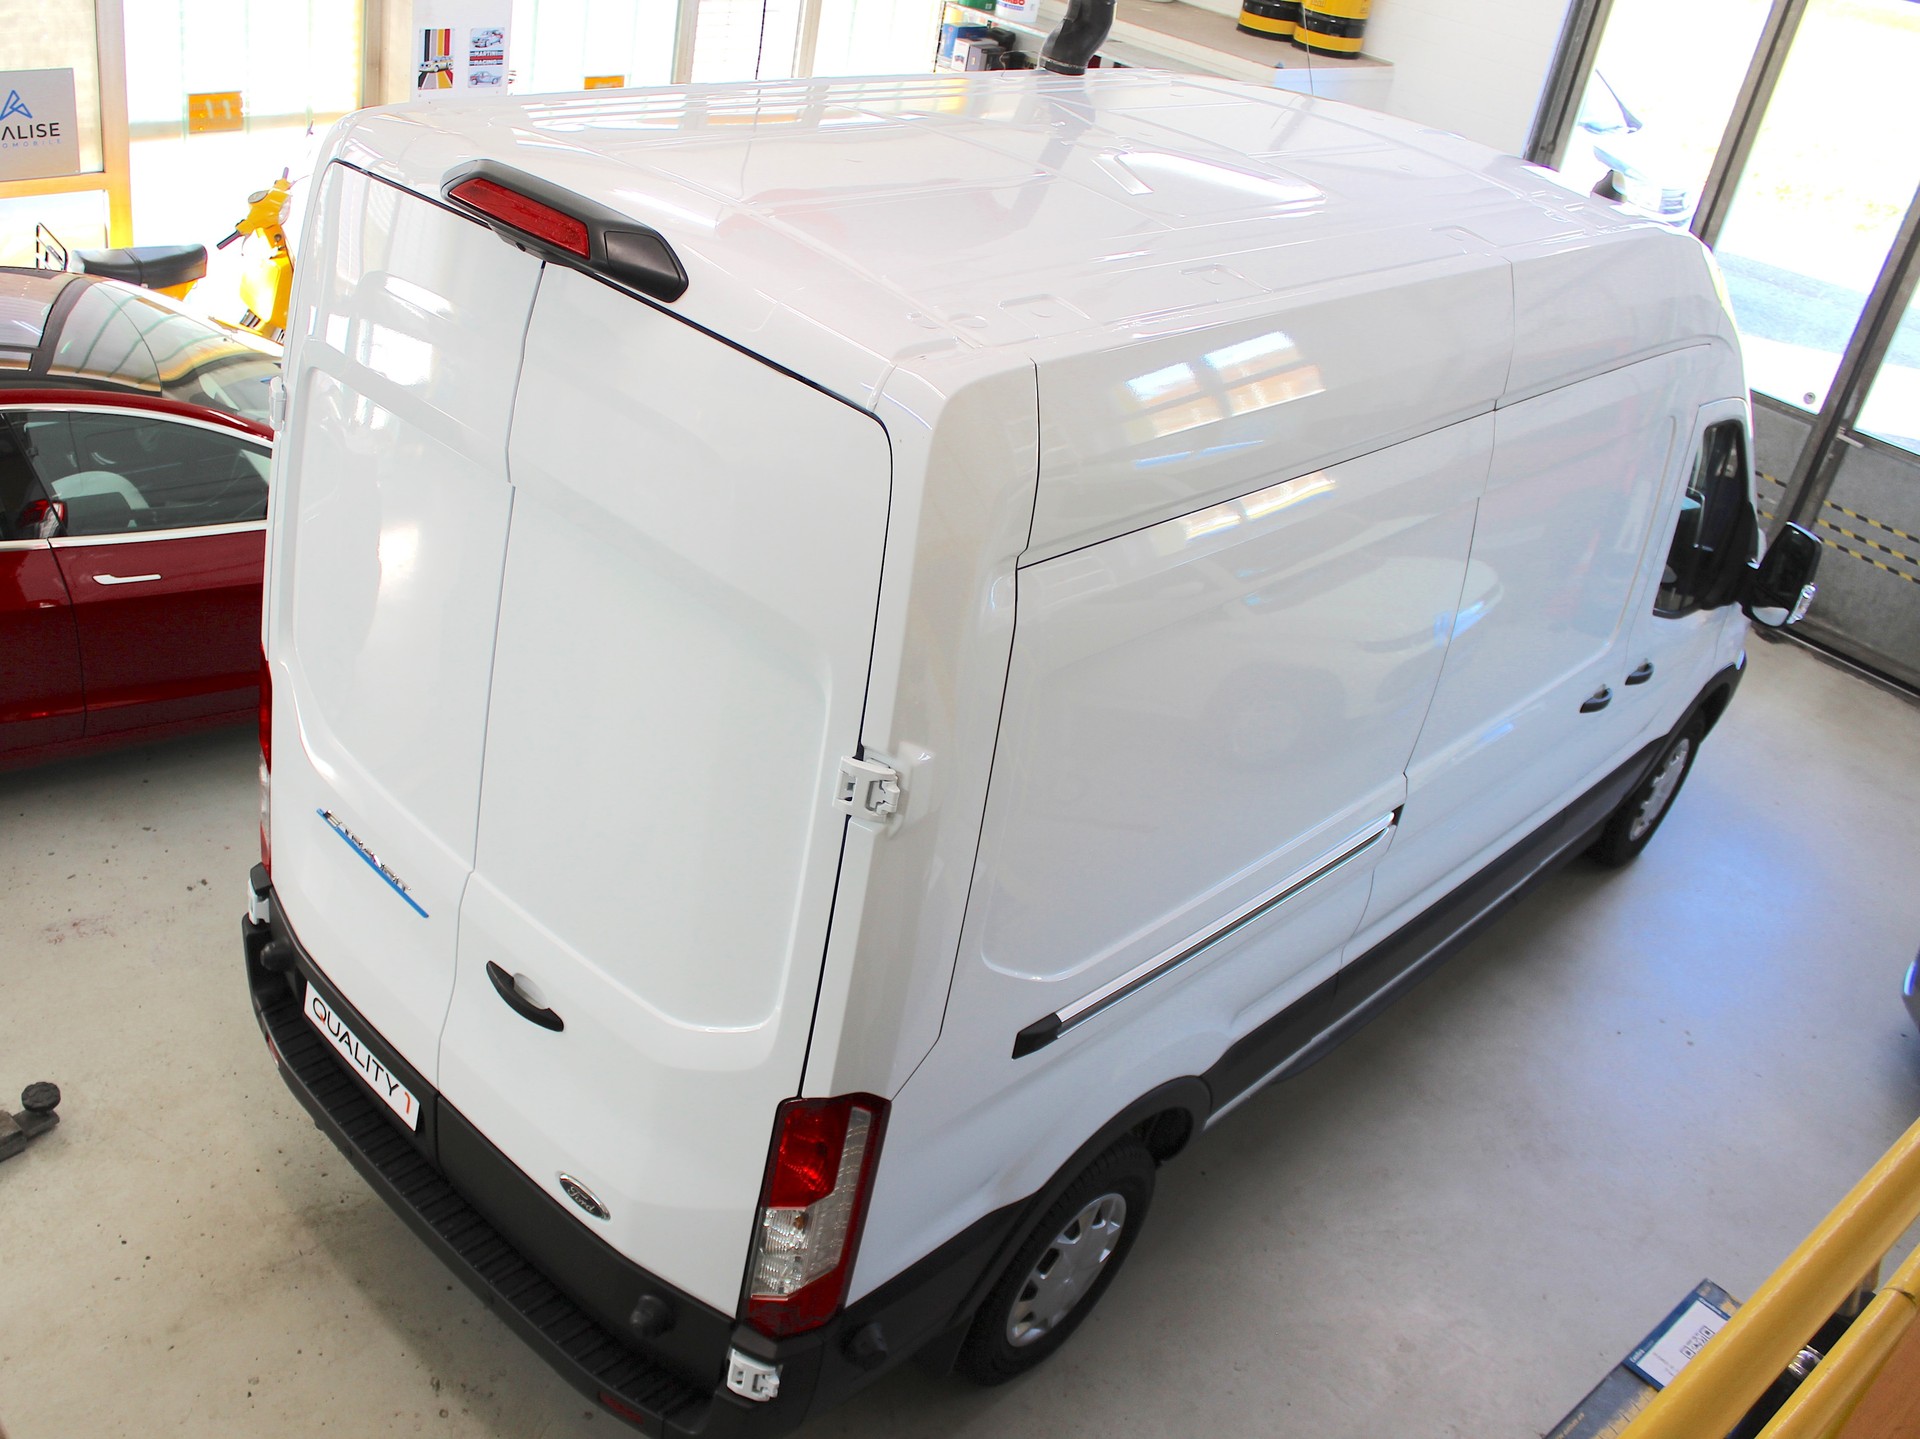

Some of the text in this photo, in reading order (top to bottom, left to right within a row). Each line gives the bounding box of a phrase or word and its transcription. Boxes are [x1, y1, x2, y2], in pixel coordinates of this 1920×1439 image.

[1, 122, 61, 141] ALISE
[312, 997, 411, 1115] QUALITY 1
[567, 1186, 596, 1213] Ford
